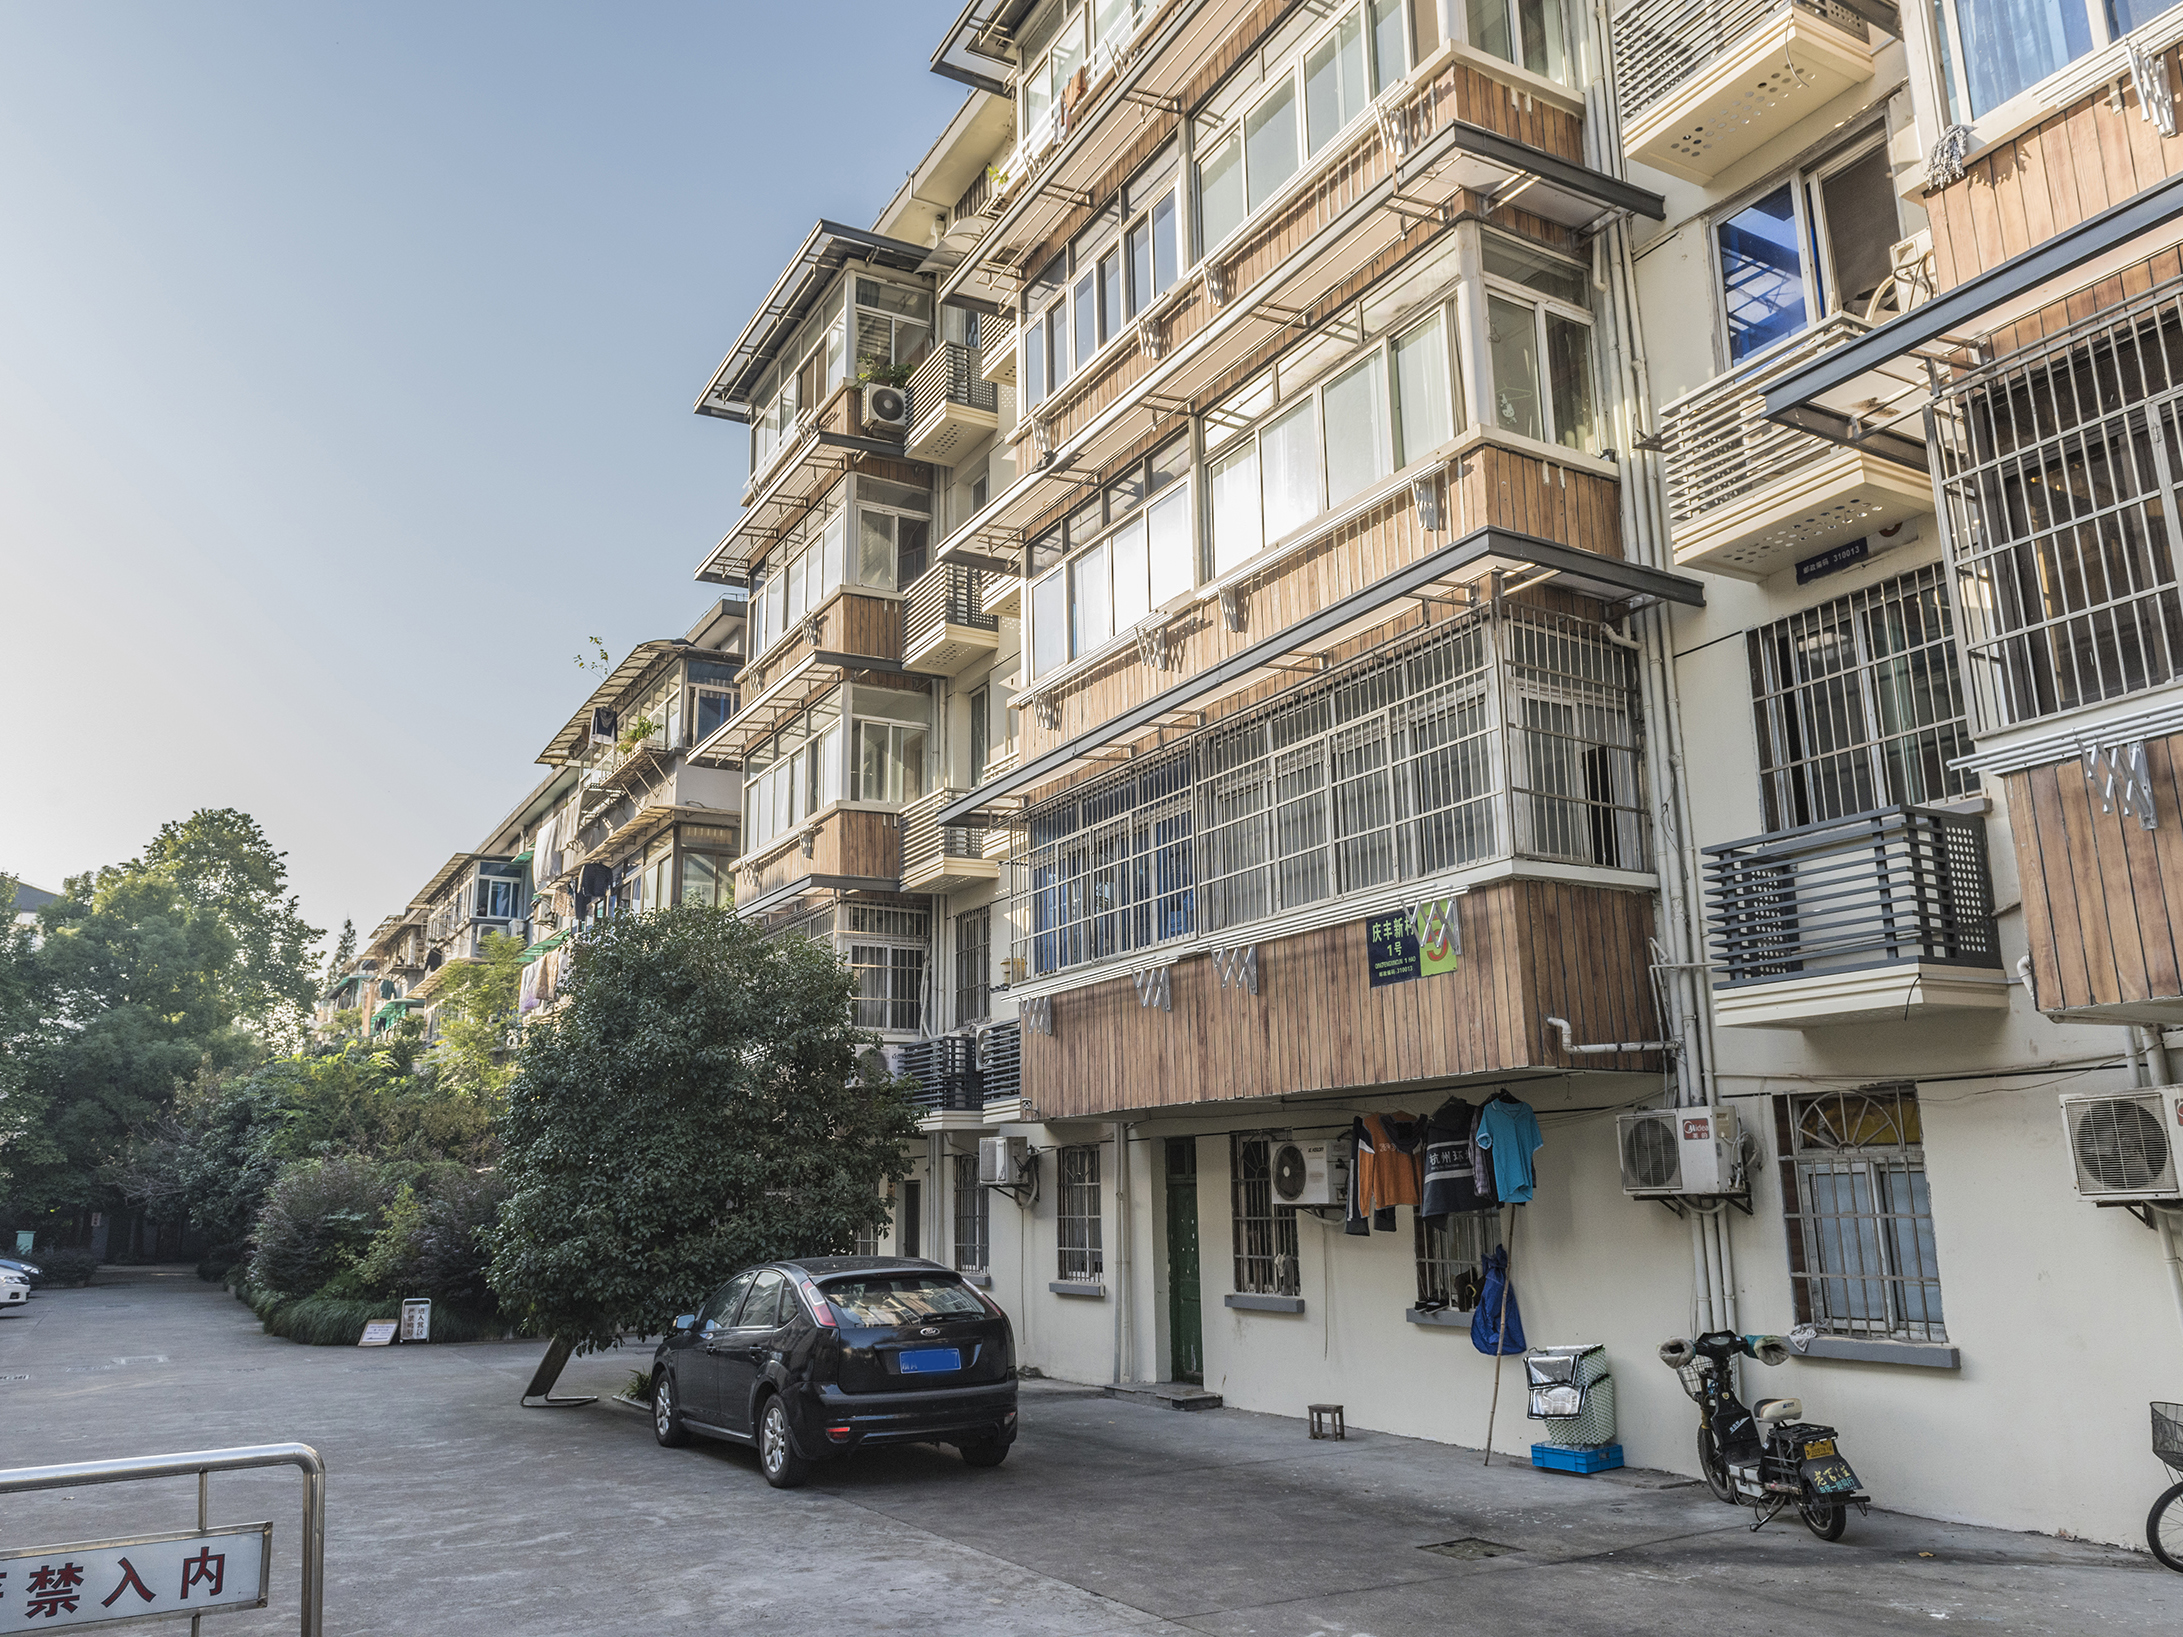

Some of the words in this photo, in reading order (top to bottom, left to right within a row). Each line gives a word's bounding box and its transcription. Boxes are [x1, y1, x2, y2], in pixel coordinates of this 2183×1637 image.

[1833, 545, 1860, 562] 310013
[1372, 915, 1414, 943] 庆丰新村
[0, 1547, 225, 1619] 禁入内
